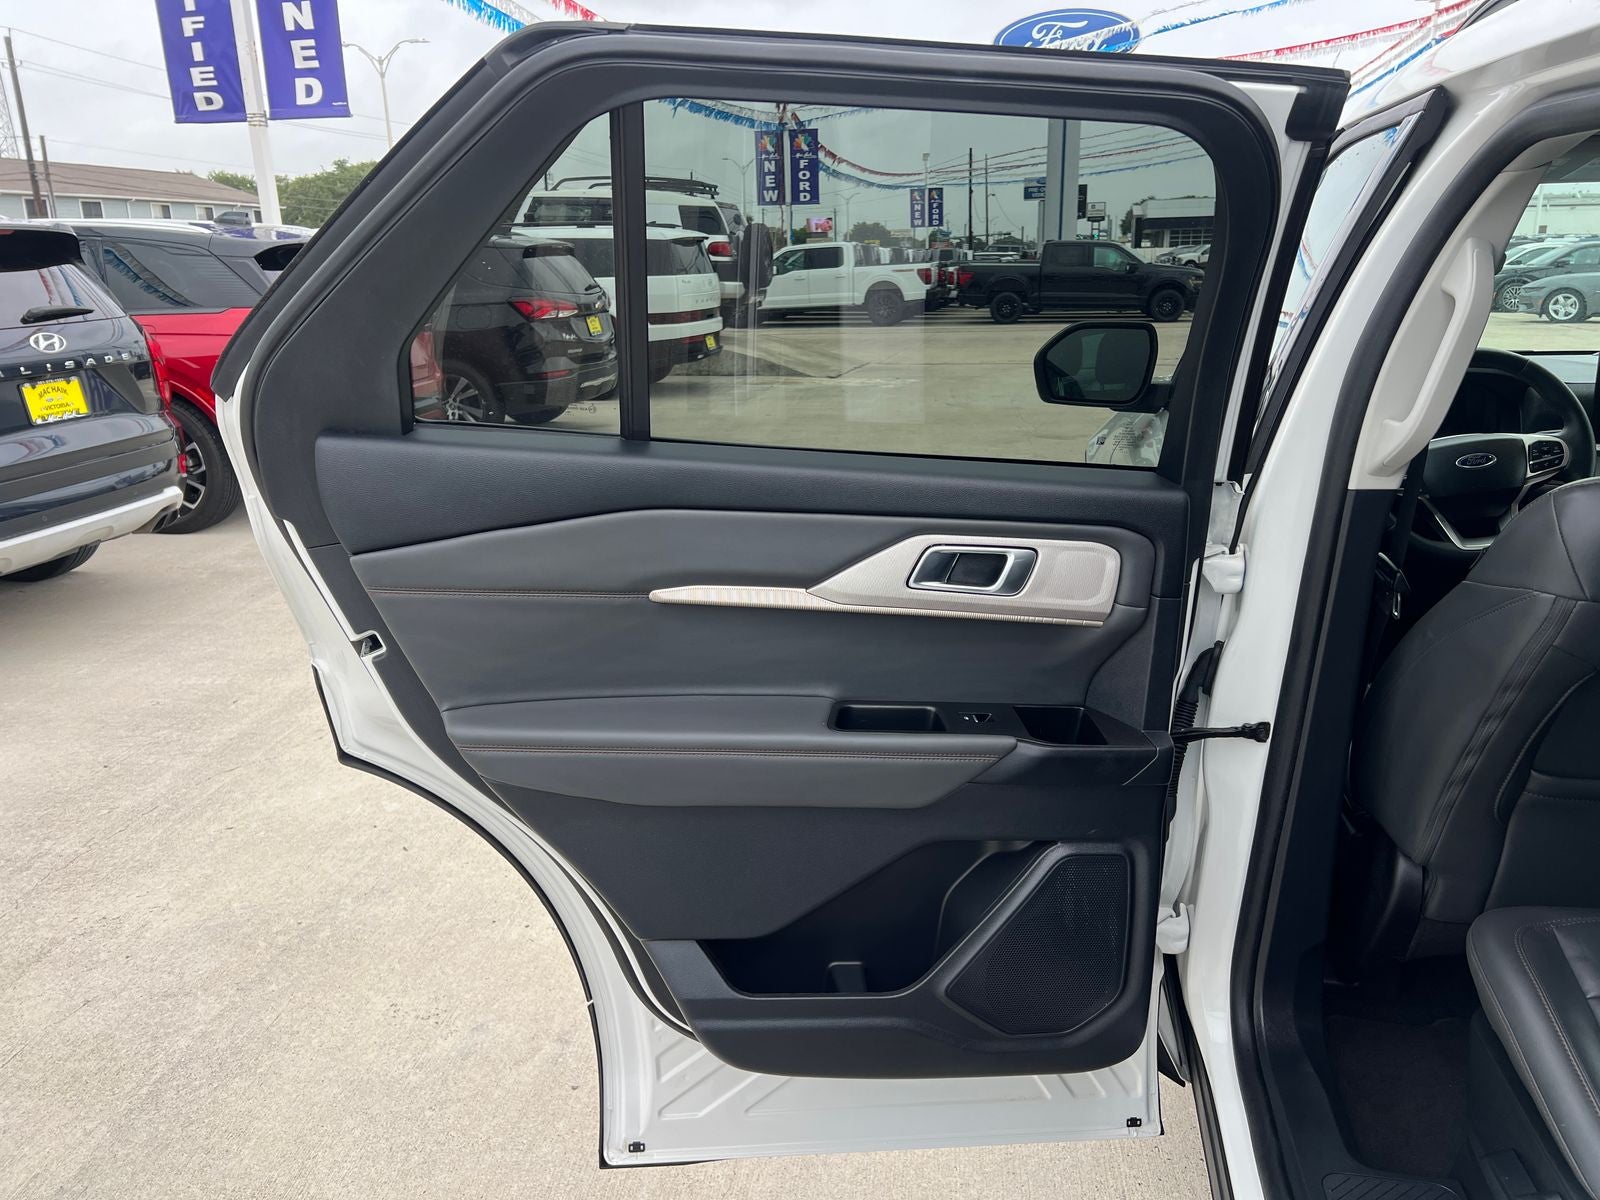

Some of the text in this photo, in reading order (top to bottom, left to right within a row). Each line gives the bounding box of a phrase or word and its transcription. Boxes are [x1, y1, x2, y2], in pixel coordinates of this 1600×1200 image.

[282, 0, 323, 105] NED
[763, 160, 779, 202] NEW
[798, 159, 811, 202] FORD
[913, 203, 923, 226] NEW
[932, 202, 940, 226] FORD
